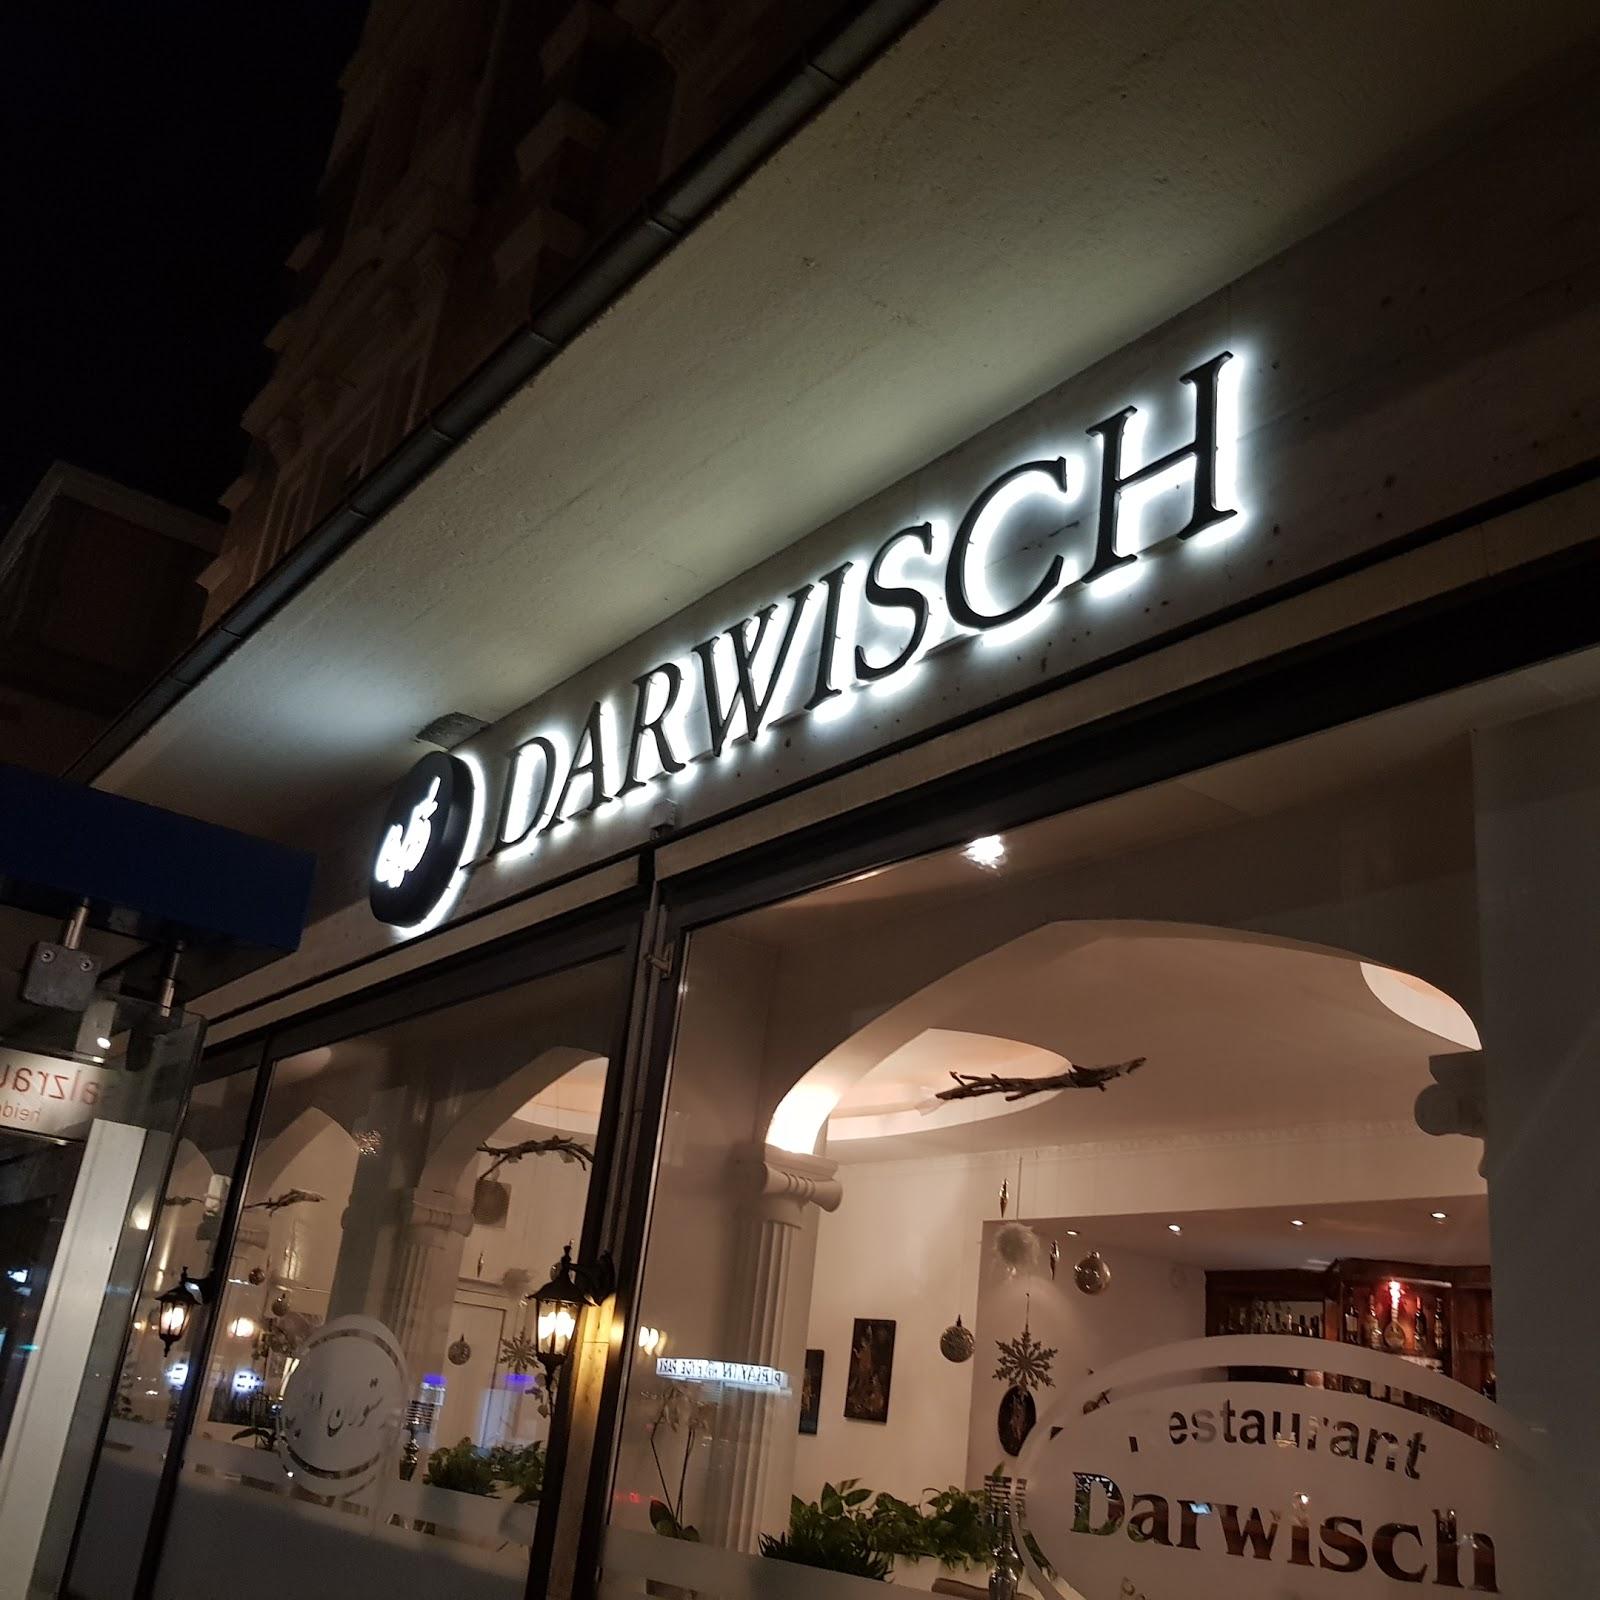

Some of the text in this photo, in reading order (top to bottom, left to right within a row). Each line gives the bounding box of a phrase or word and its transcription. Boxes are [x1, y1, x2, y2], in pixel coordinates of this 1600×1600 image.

[489, 350, 1239, 857] DARWISCH
[1128, 1399, 1427, 1480] estaurant
[1070, 1471, 1499, 1593] Darwisch
